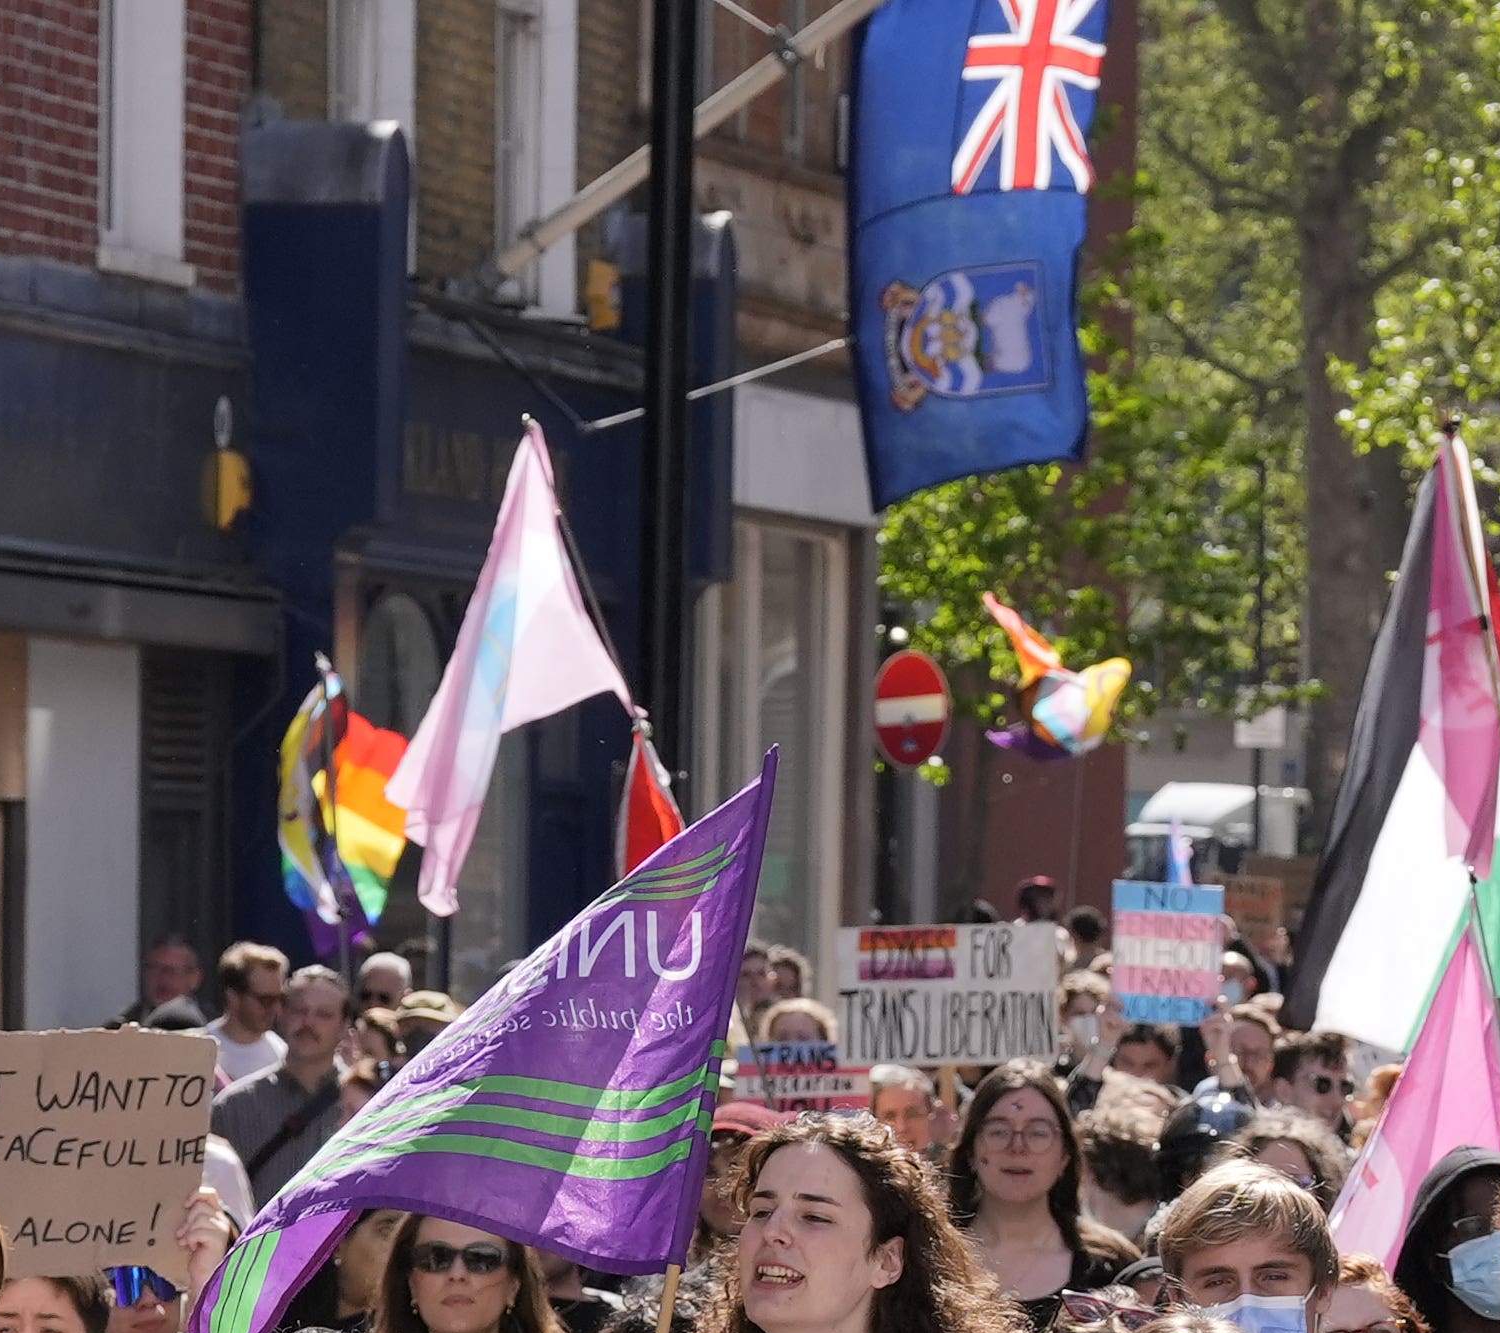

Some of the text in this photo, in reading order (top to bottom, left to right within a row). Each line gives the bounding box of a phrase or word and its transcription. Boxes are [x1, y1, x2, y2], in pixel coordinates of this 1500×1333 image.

[1144, 886, 1192, 912] NO
[969, 928, 1012, 980] FOR
[1122, 965, 1206, 997] TRANS
[35, 1069, 160, 1113] WANT
[164, 1073, 207, 1109] TO
[157, 1135, 207, 1168] LIFE
